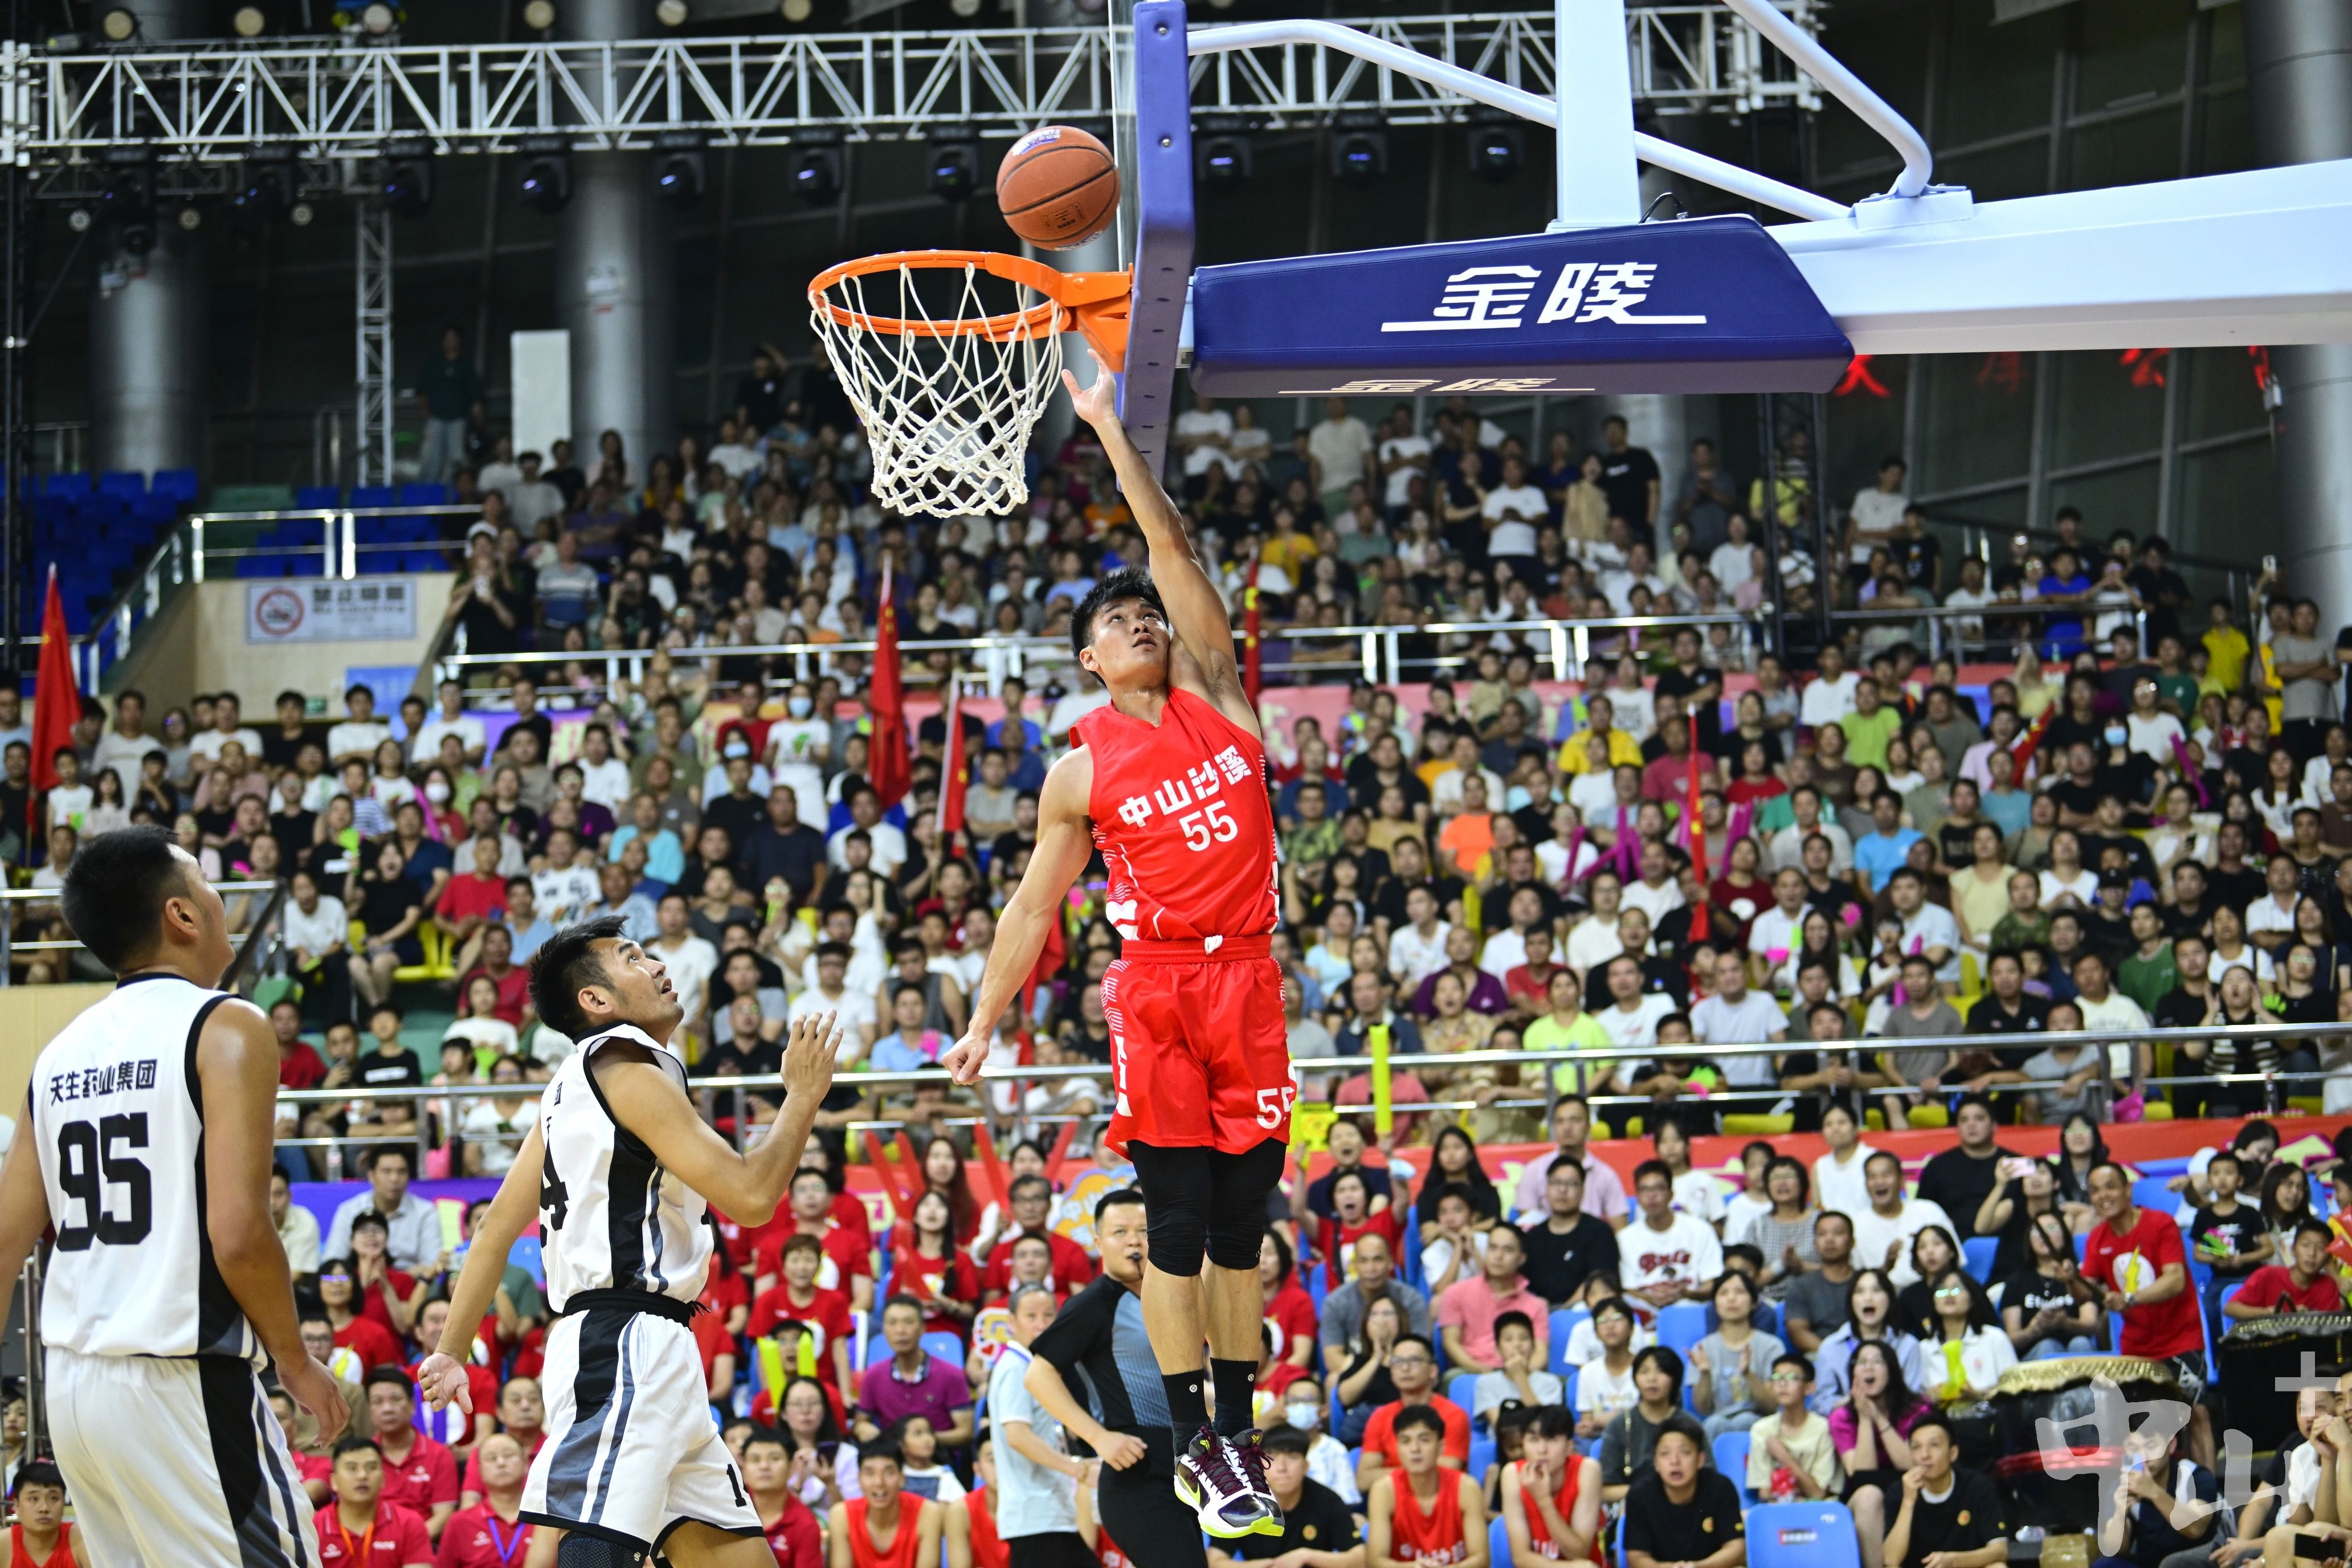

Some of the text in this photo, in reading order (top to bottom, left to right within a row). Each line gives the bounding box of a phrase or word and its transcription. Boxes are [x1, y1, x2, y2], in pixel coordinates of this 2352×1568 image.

[1381, 263, 1707, 332] 金陵
[1118, 745, 1252, 828] 中山沙溪
[1179, 800, 1238, 851] 55
[50, 1059, 158, 1106] 天生药业集团
[56, 1112, 153, 1252] 95
